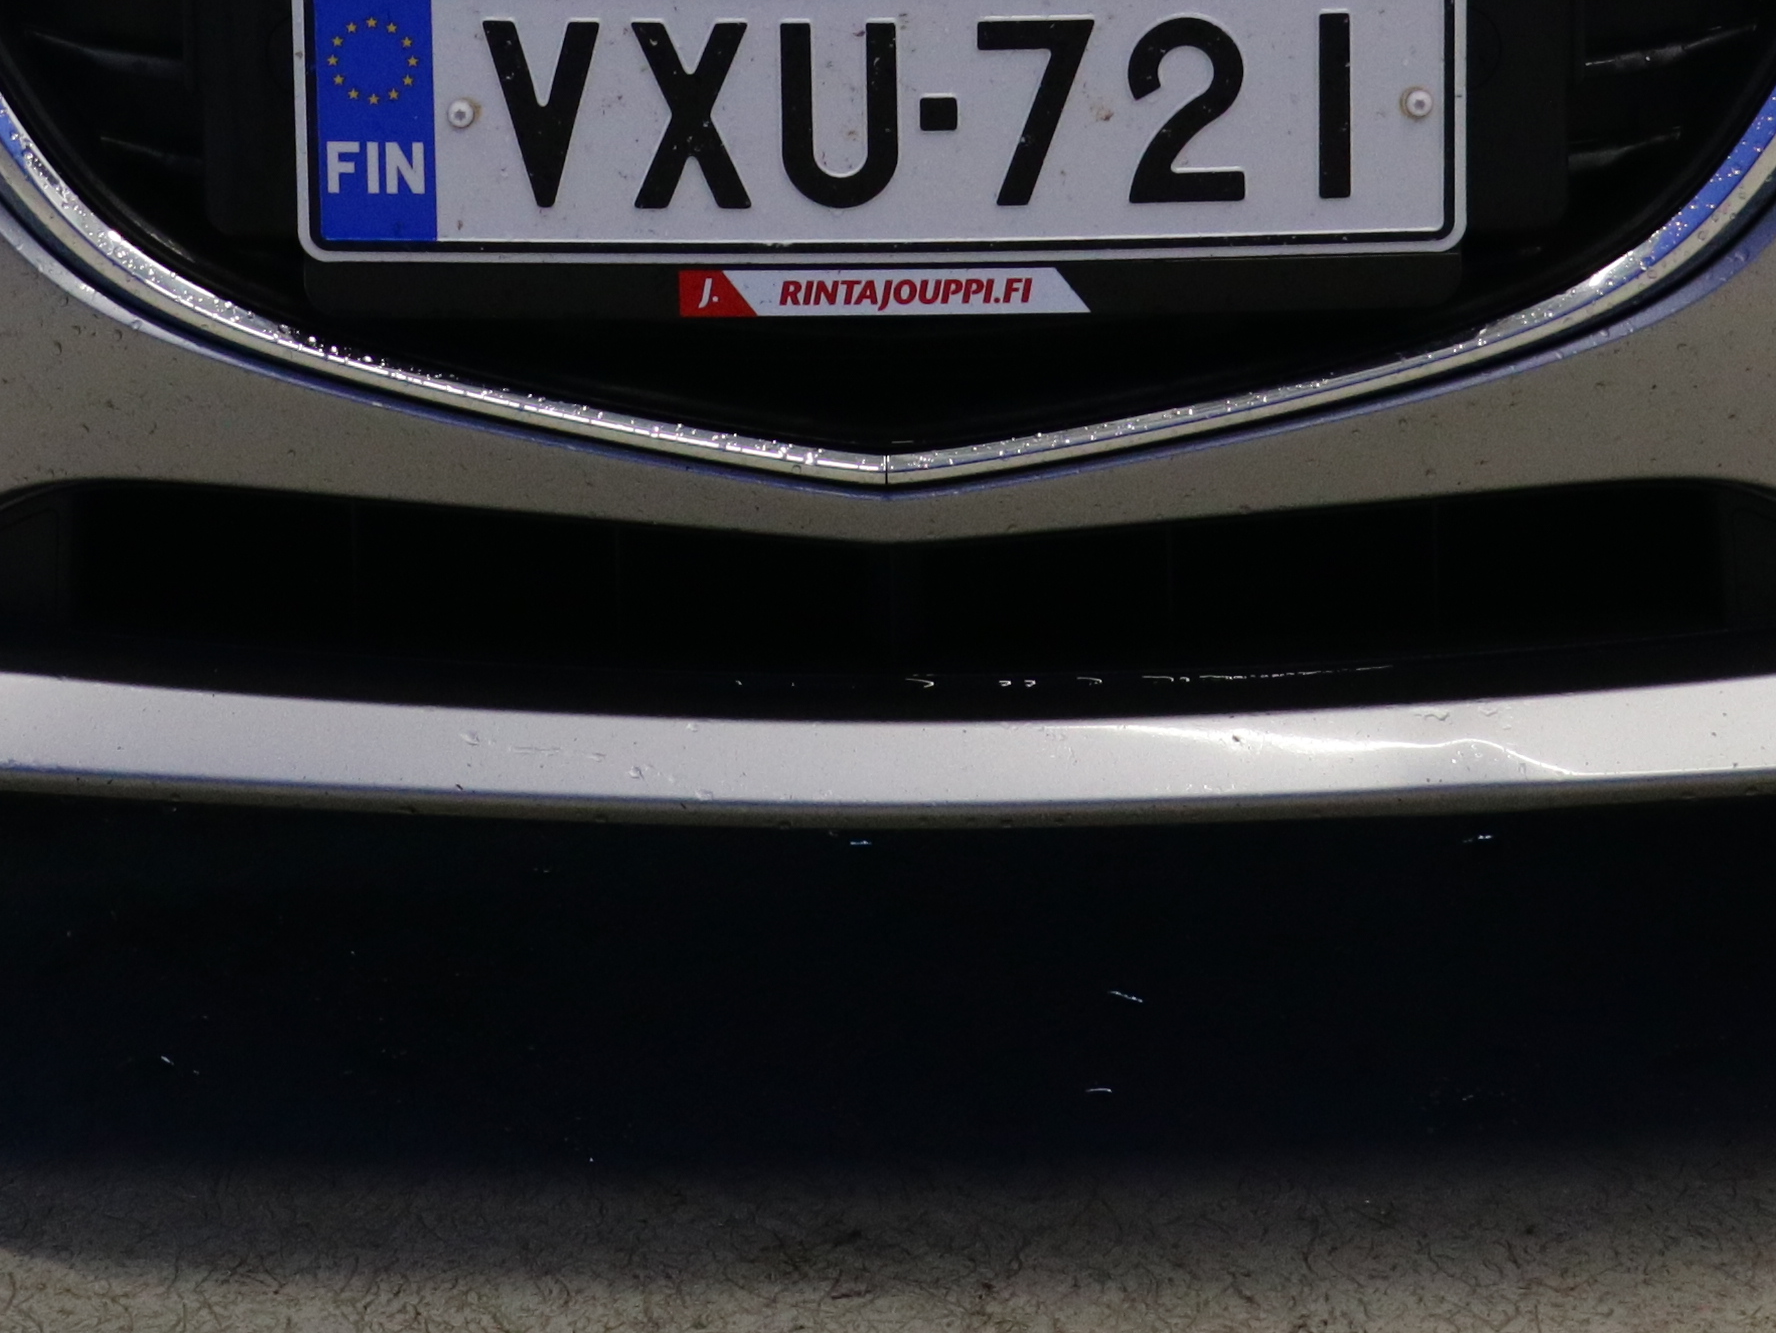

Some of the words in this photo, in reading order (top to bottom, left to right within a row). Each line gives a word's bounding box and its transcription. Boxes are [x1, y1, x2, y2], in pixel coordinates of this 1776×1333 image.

[482, 12, 1352, 210] VXU-721
[328, 140, 426, 197] FIN
[778, 278, 1032, 311] RINTAJOUPPI.FI
